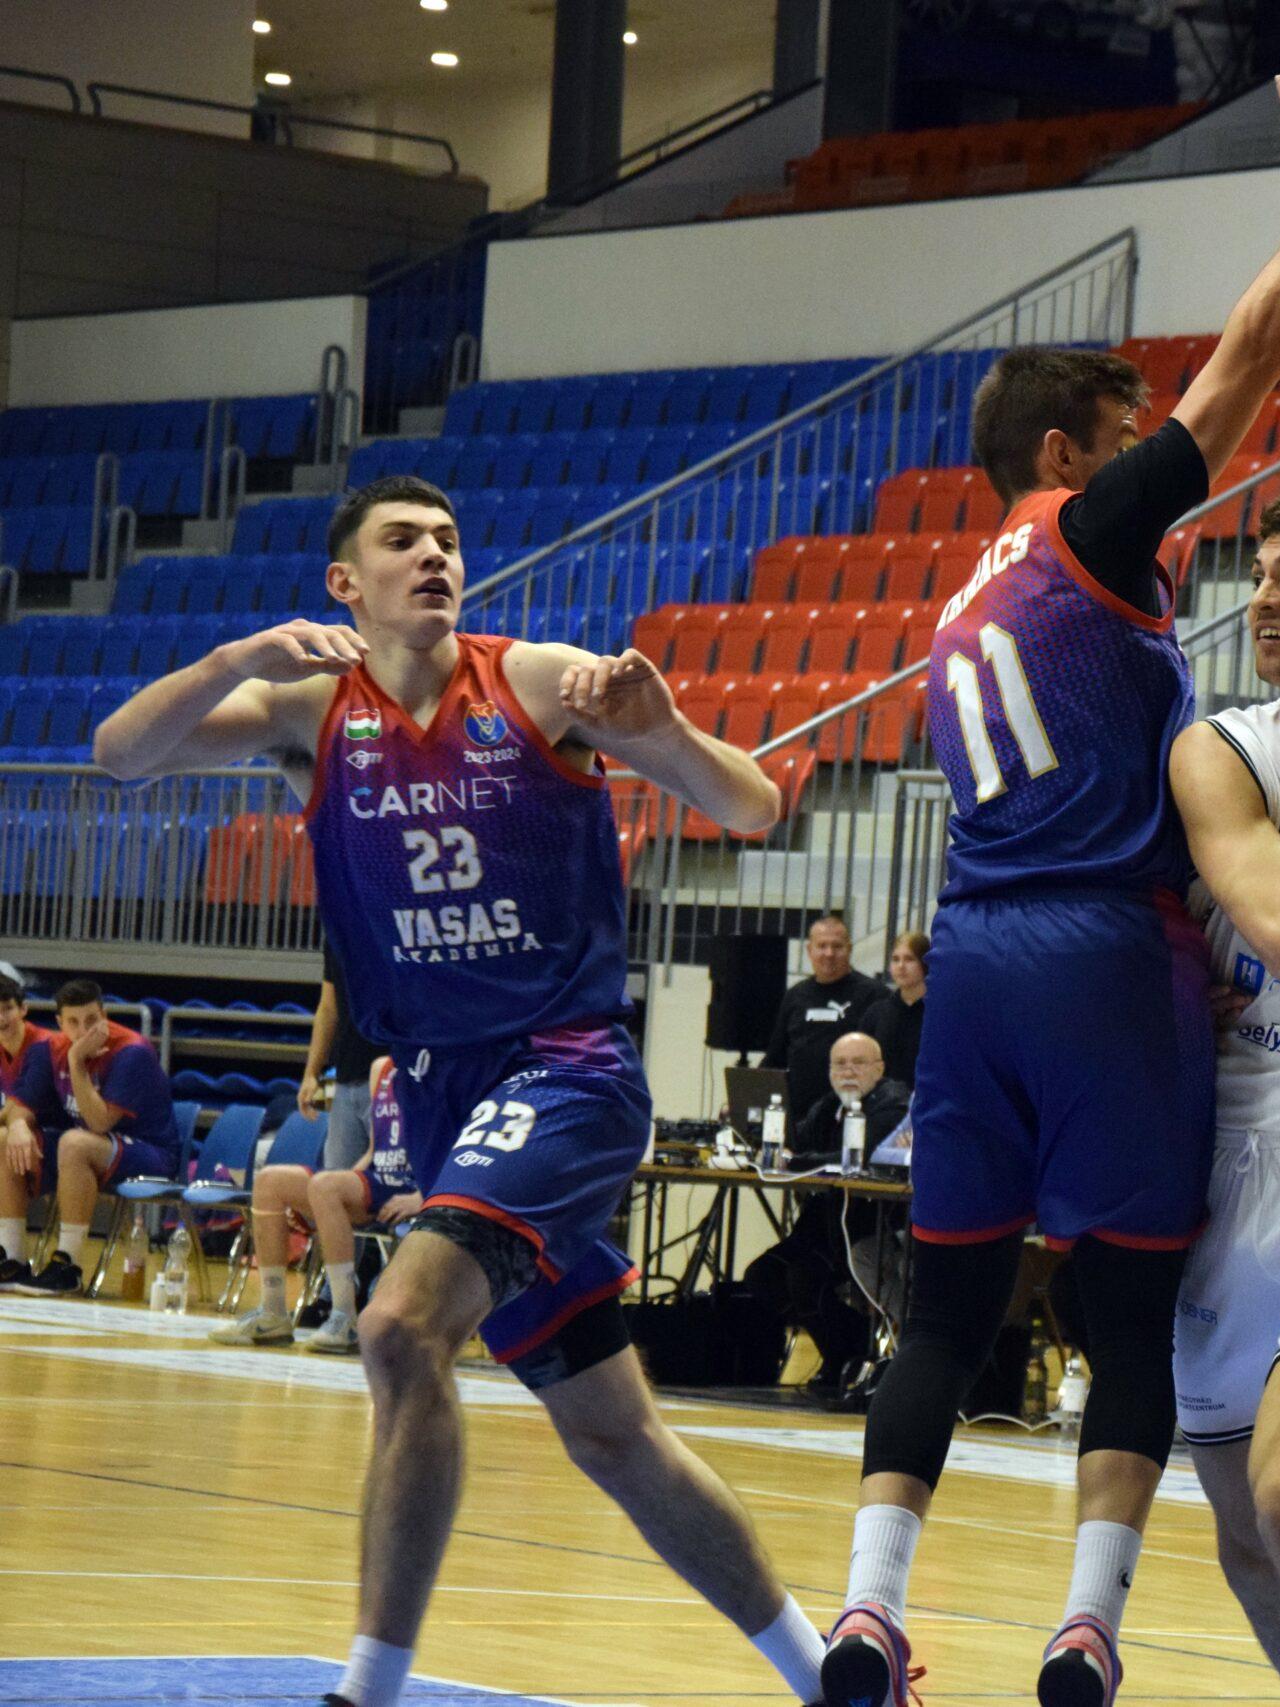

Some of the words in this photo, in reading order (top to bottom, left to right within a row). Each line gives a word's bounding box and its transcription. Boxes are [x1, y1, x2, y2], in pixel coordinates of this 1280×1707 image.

[946, 621, 1060, 805] 11
[350, 775, 517, 819] CARNET
[402, 826, 483, 894] 23
[392, 899, 522, 948] VASAS
[452, 1100, 537, 1152] 23
